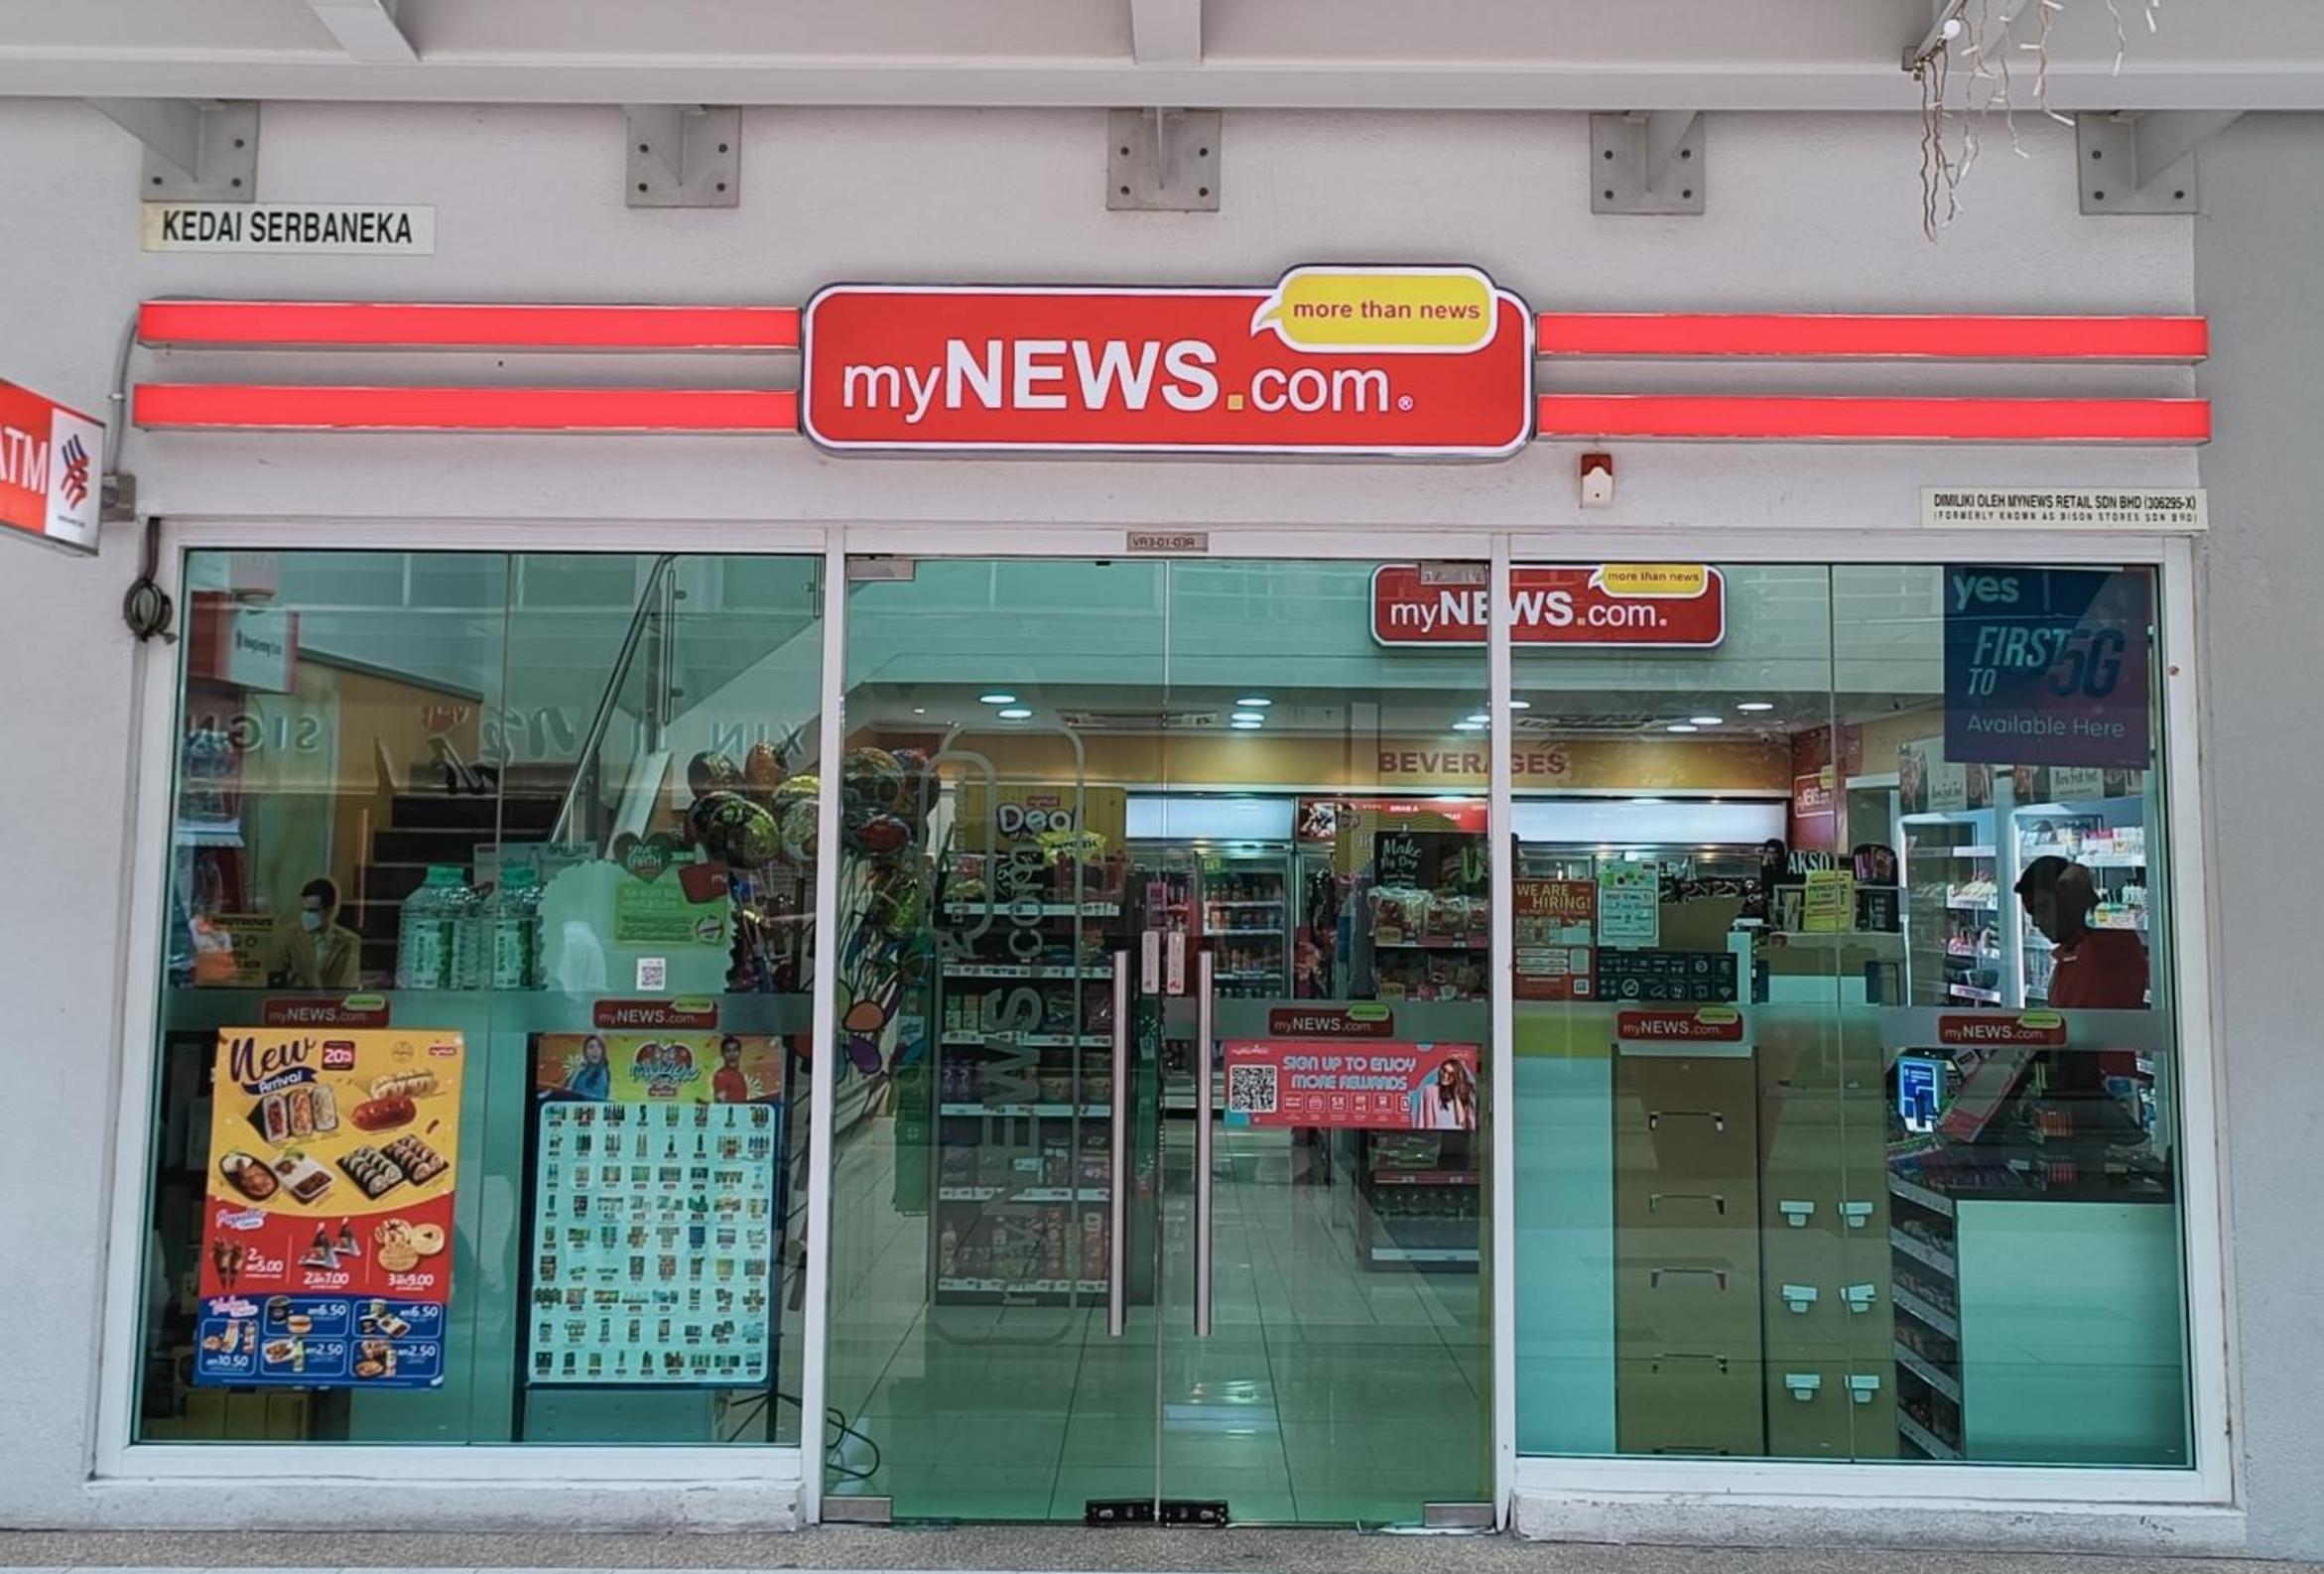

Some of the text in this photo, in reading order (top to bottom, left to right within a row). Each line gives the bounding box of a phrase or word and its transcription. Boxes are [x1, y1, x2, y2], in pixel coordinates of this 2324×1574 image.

[162, 210, 413, 243] KEDAI SERBANEKA
[1293, 300, 1482, 320] more than news
[1933, 493, 2196, 511] DIMILIKI OLEH MYNEWS RETAIL SDN BHD (306295-X)
[2000, 511, 2036, 521] KNOWN
[2042, 511, 2055, 521] AS
[2060, 511, 2094, 522] BISON
[2099, 512, 2140, 523] STORES
[2144, 512, 2165, 523] SDN
[1608, 570, 1700, 584] more than news
[1952, 575, 2019, 611] yes
[1973, 625, 2126, 699] FIRST 5G
[1968, 668, 1997, 696] TO
[1967, 715, 2126, 738] Available Here
[1516, 883, 1570, 898] WE ARE
[1532, 895, 1592, 910] HIRING!
[229, 1036, 316, 1082] New
[1322, 1057, 1342, 1073] UP
[1346, 1056, 1364, 1073] TO
[258, 1070, 303, 1094] Arrival
